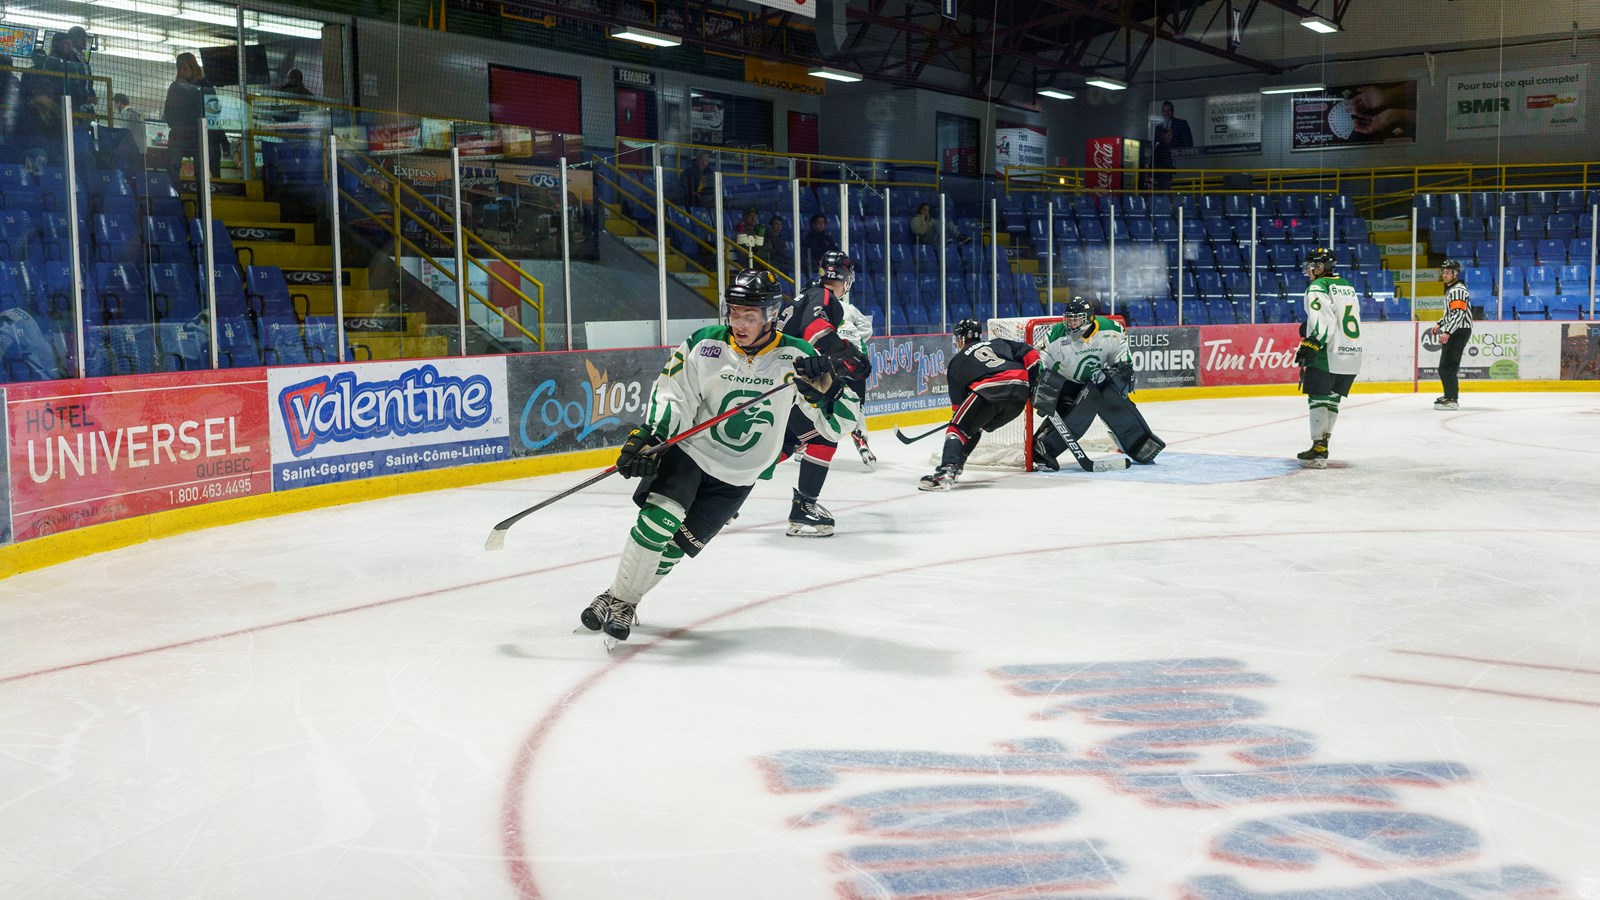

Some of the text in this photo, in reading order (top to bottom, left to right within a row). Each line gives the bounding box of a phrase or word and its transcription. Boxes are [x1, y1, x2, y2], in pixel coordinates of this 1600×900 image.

[619, 69, 651, 85] FEMMES
[1457, 82, 1480, 91] Pour
[1482, 80, 1503, 89] tout
[1517, 77, 1534, 88] qui
[1536, 74, 1579, 85] compte!
[1457, 97, 1510, 115] BMR
[393, 165, 437, 179] Express
[532, 174, 556, 188] CRS
[236, 228, 266, 238] CRS
[292, 272, 322, 281] CRS
[827, 271, 836, 279] 72
[1401, 271, 1434, 279] Deardins
[1310, 297, 1322, 311] 6
[349, 319, 378, 328] CRS
[1342, 304, 1361, 339] 6
[1129, 334, 1169, 347] EUBLES
[1422, 333, 1517, 346] AU NIQUES
[974, 345, 1006, 368] 9
[1203, 336, 1301, 372] Tim Hort
[1481, 345, 1517, 357] COIN
[1132, 349, 1195, 372] OIRIER
[720, 373, 774, 386] CONDORS
[288, 370, 488, 441] Valentine
[901, 400, 927, 410] OFFICIEL
[26, 402, 95, 433] HÔTEL
[492, 416, 503, 425] MC
[27, 416, 251, 484] UNIVERSEL
[196, 457, 252, 478] QUÉBEC
[282, 444, 504, 482] Saint-Georges Saint-Côme-Linière
[169, 478, 252, 505] 1.800.463.4495
